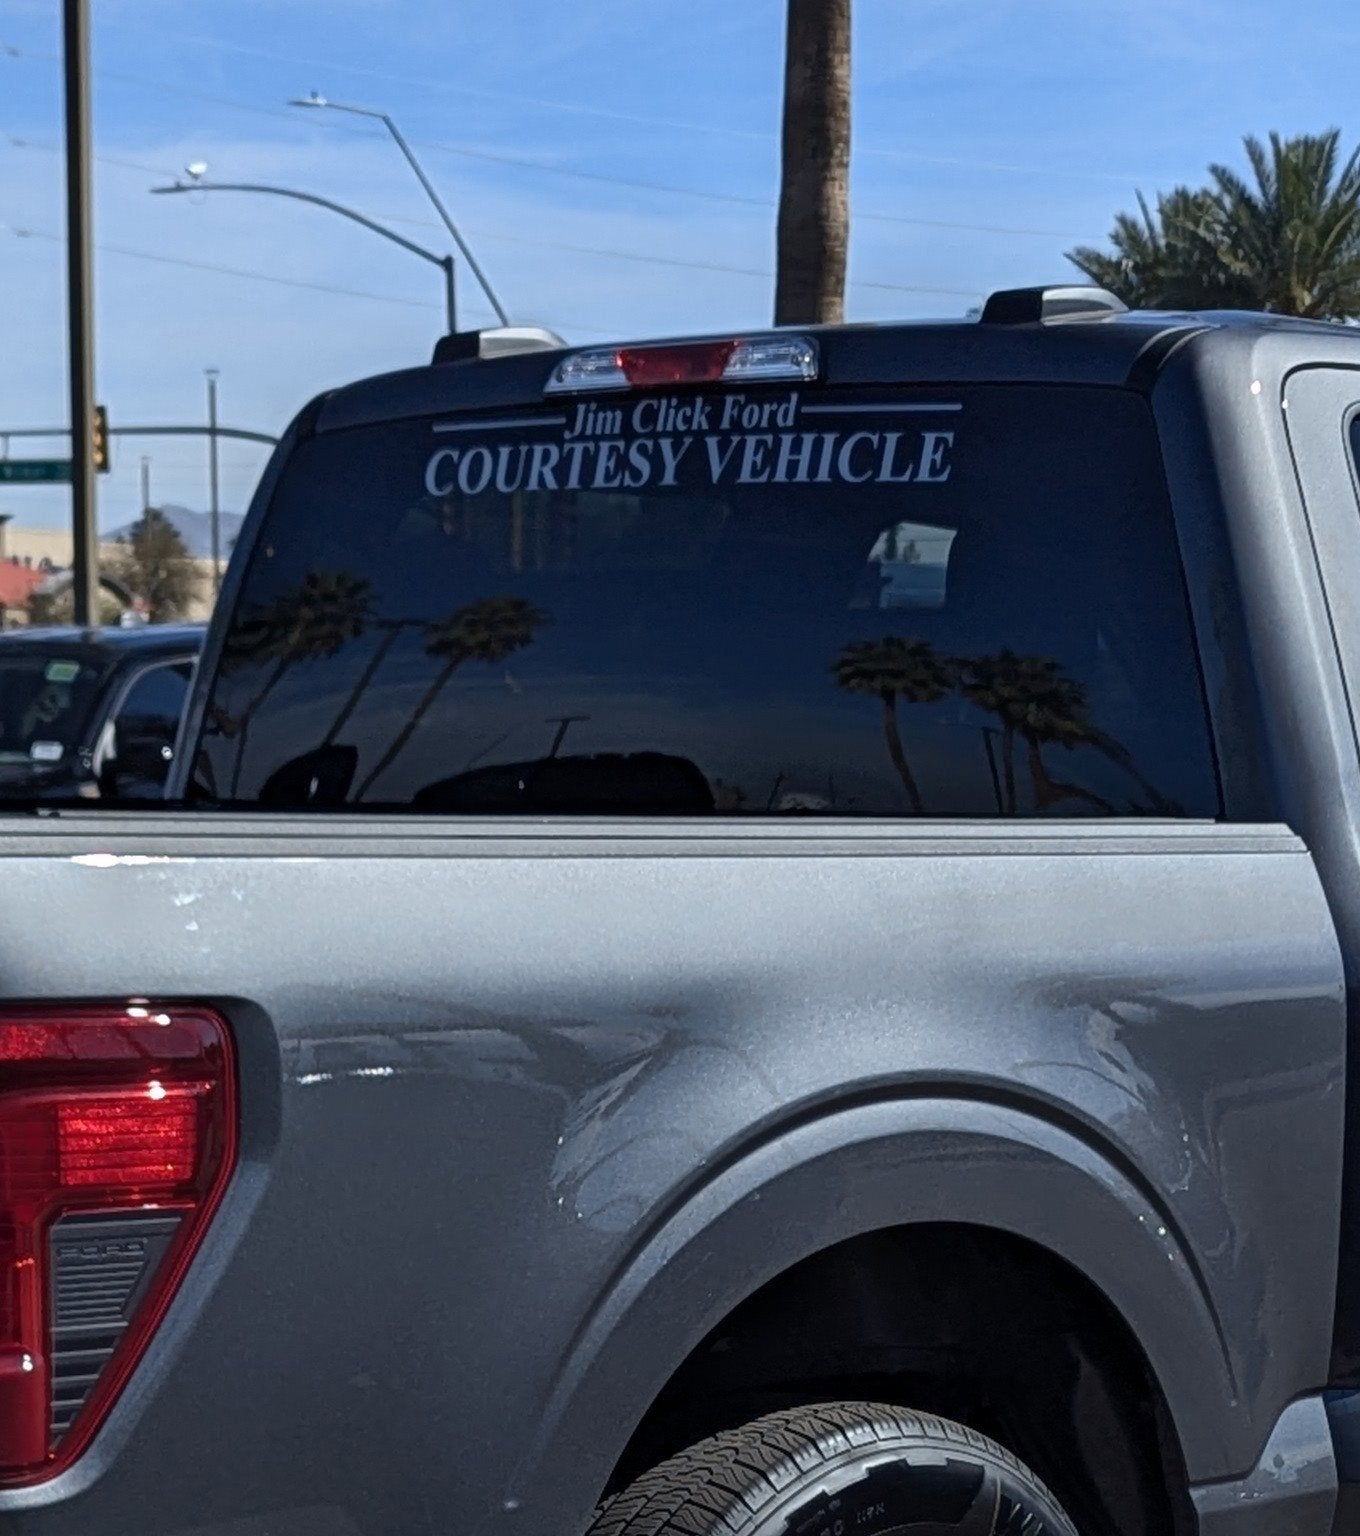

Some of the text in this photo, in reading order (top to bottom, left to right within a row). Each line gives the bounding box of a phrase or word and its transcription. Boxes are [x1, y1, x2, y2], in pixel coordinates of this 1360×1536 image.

[564, 392, 800, 440] Jim Click Ford
[425, 430, 954, 496] COURTESY VEHICLE
